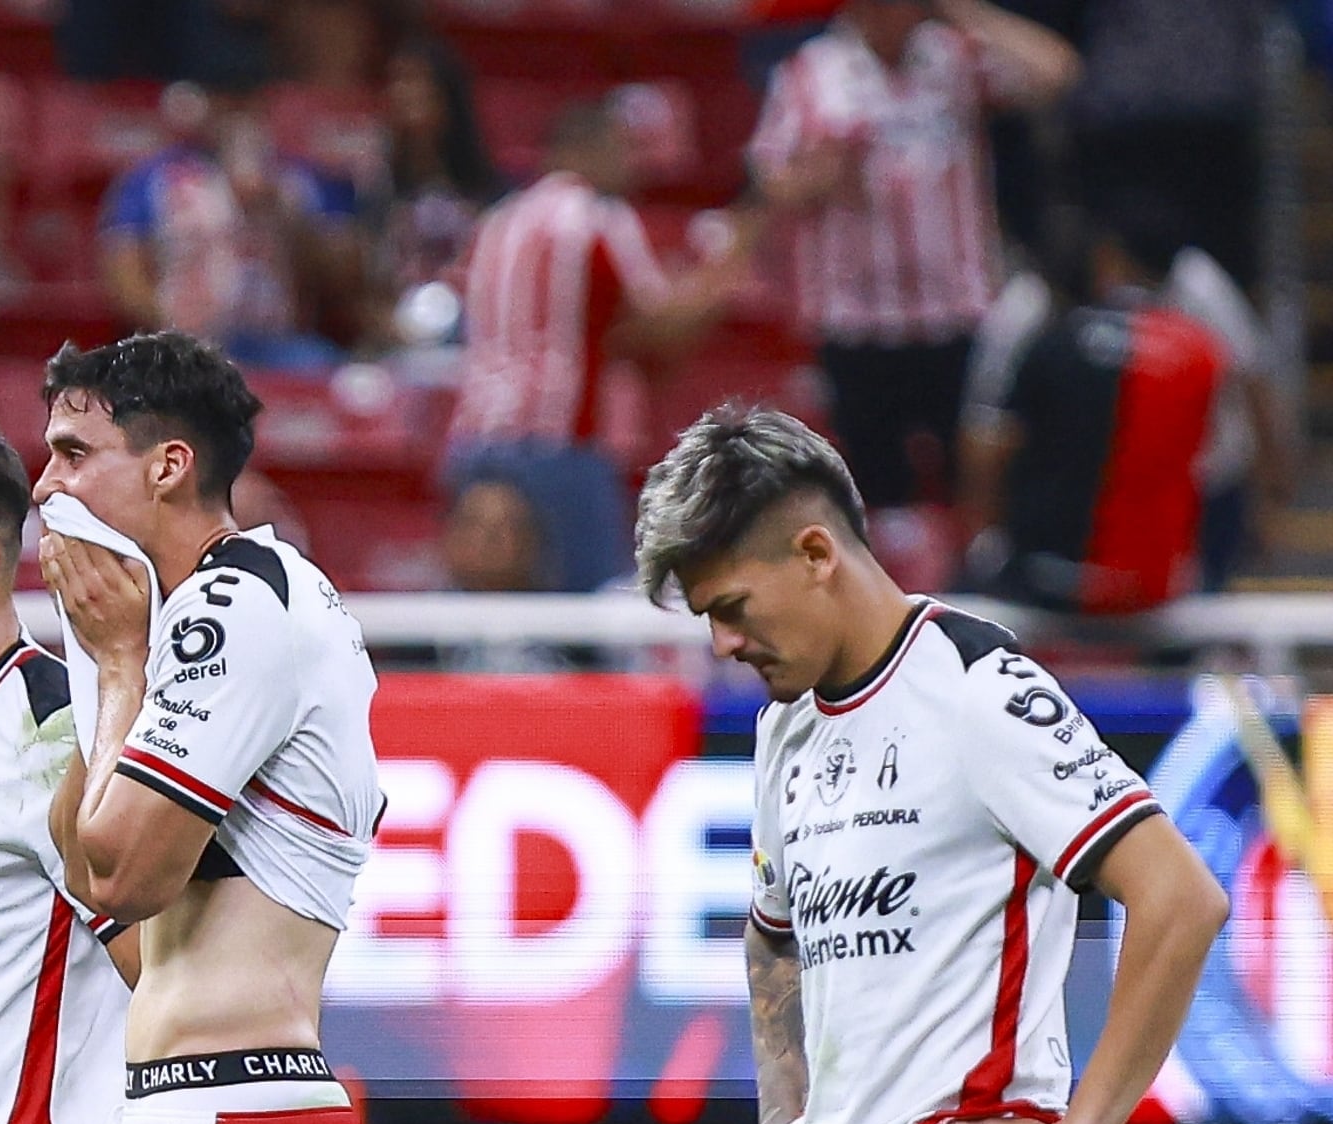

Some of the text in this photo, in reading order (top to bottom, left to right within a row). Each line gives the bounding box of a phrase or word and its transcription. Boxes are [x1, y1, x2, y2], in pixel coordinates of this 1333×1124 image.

[173, 658, 227, 684] Berel
[159, 716, 178, 731] de
[853, 809, 920, 828] PERDURA
[141, 1059, 217, 1090] CHARLY
[243, 1053, 330, 1076] CHARLY
